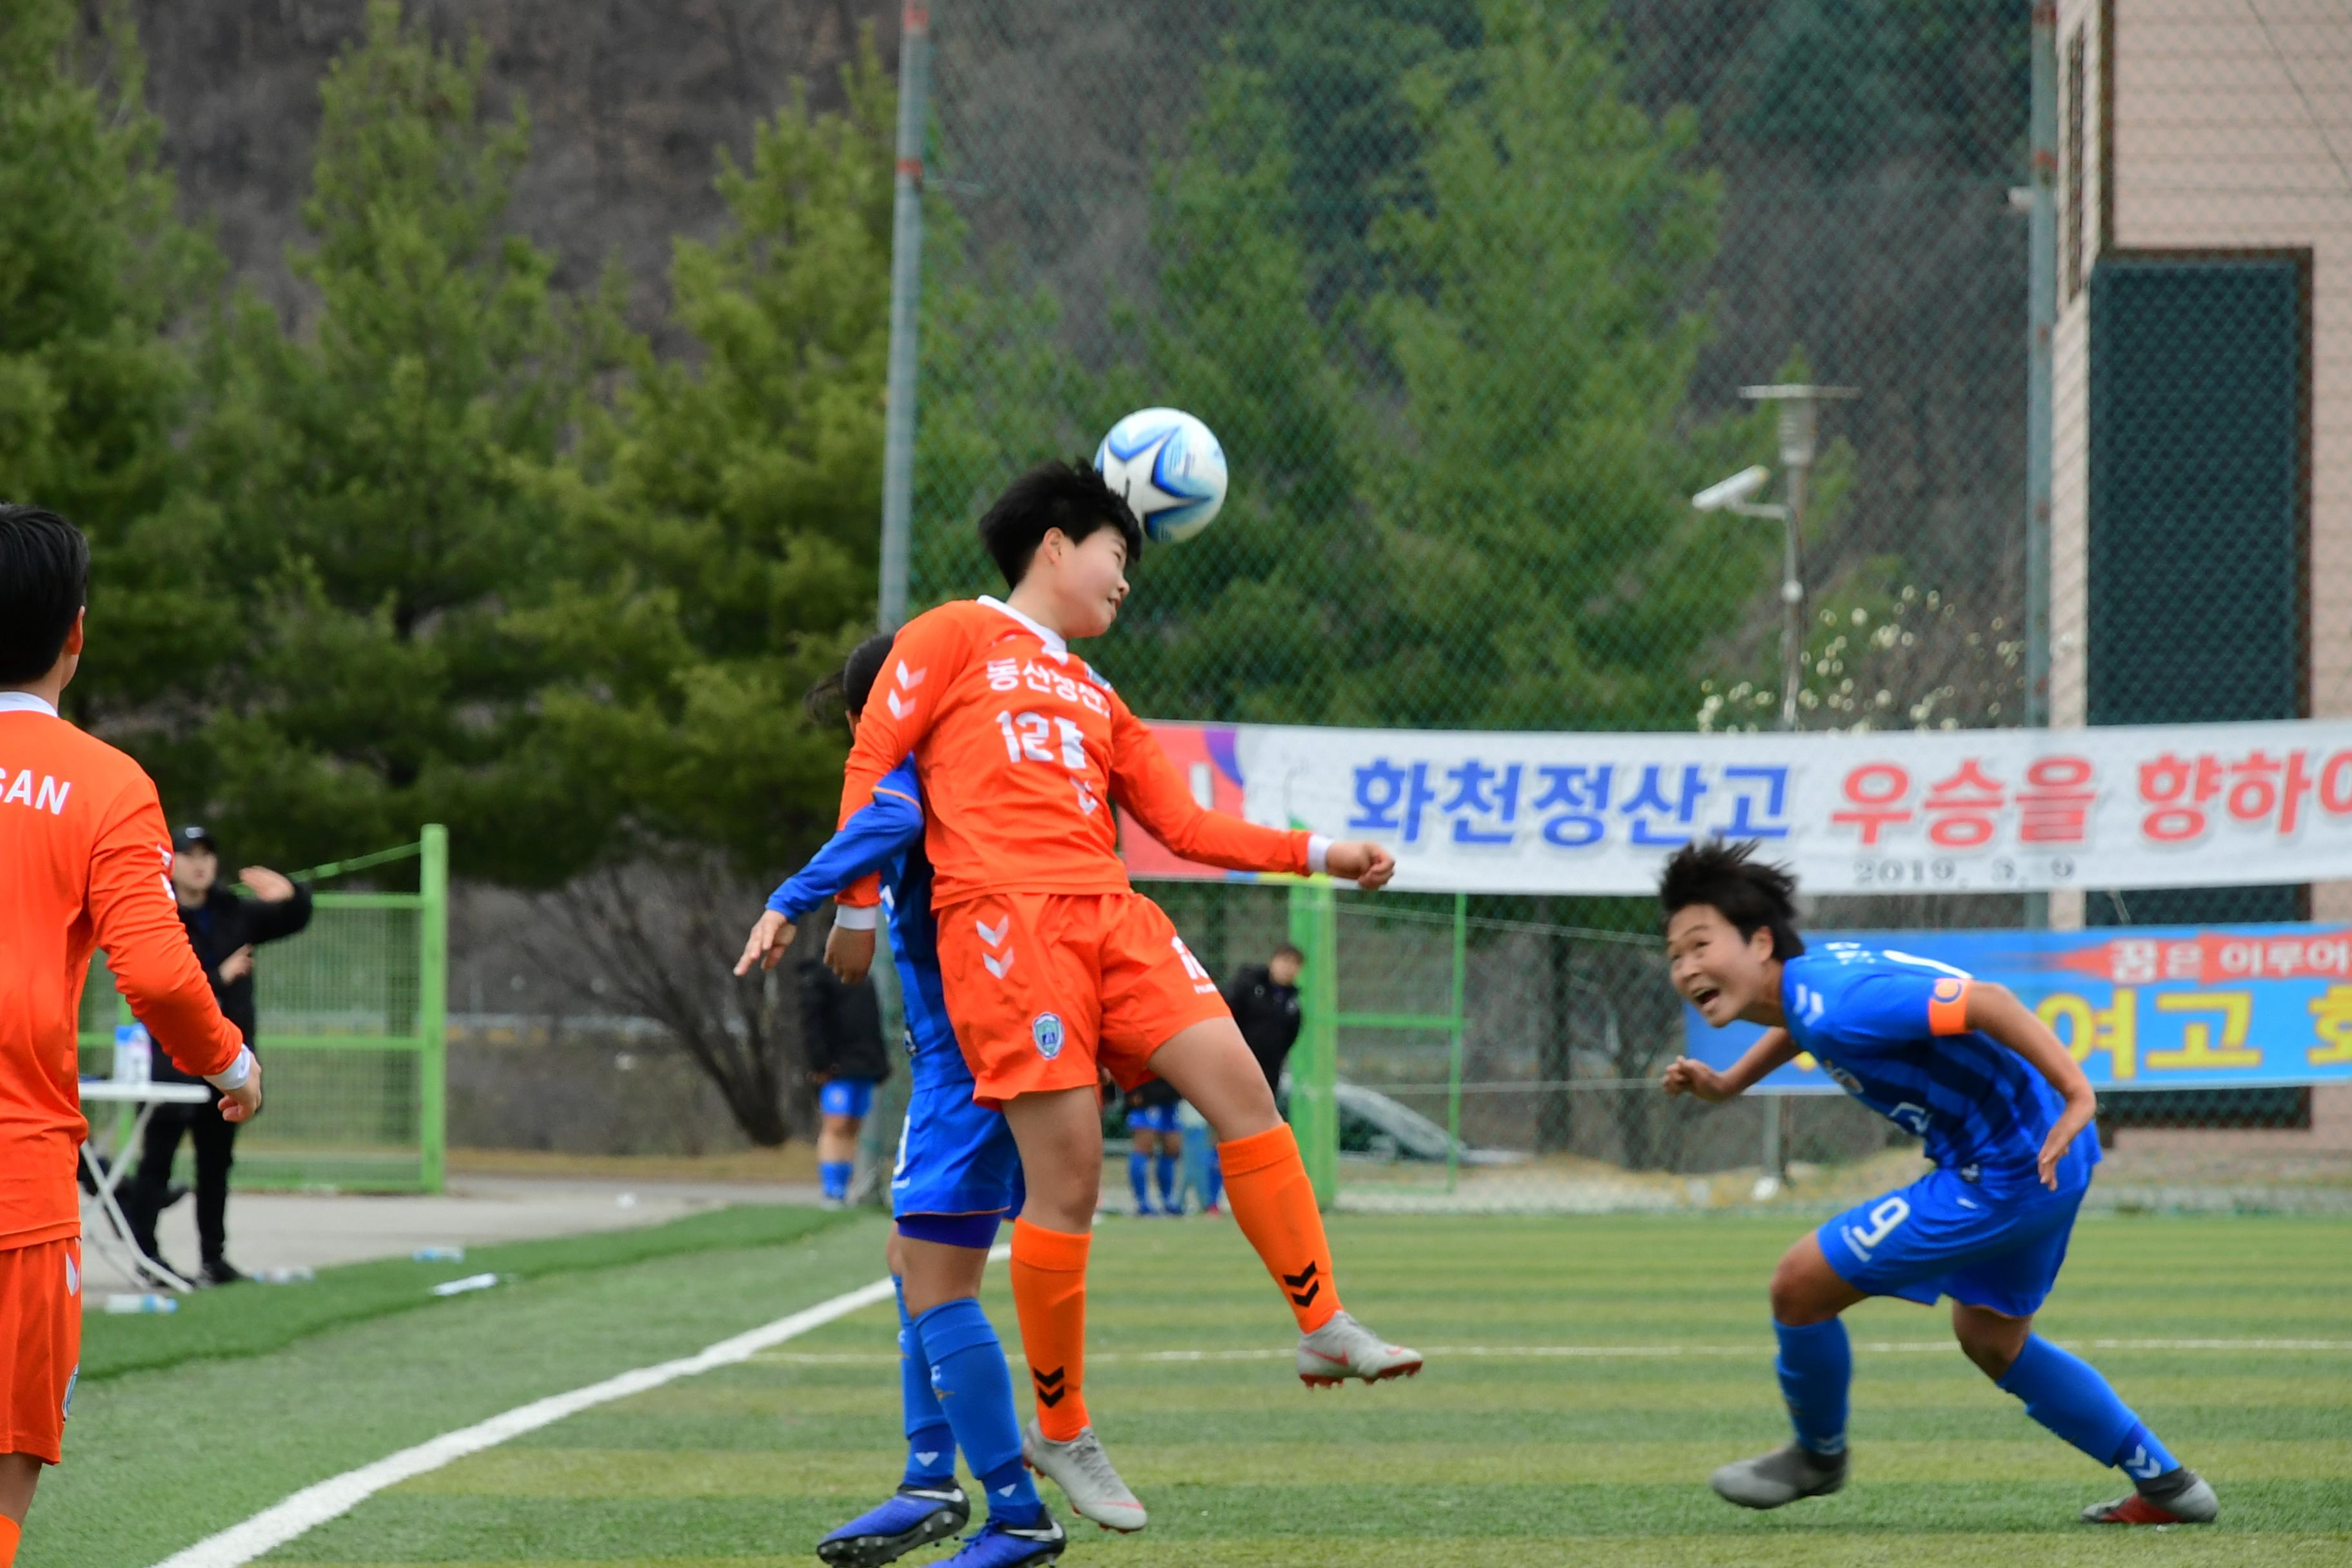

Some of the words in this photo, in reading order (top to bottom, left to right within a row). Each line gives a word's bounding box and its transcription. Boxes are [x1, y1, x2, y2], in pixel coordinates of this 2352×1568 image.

[1348, 757, 1790, 847] 화천정산고
[1831, 757, 2095, 847] 우승을
[1852, 1196, 1911, 1248] 9
